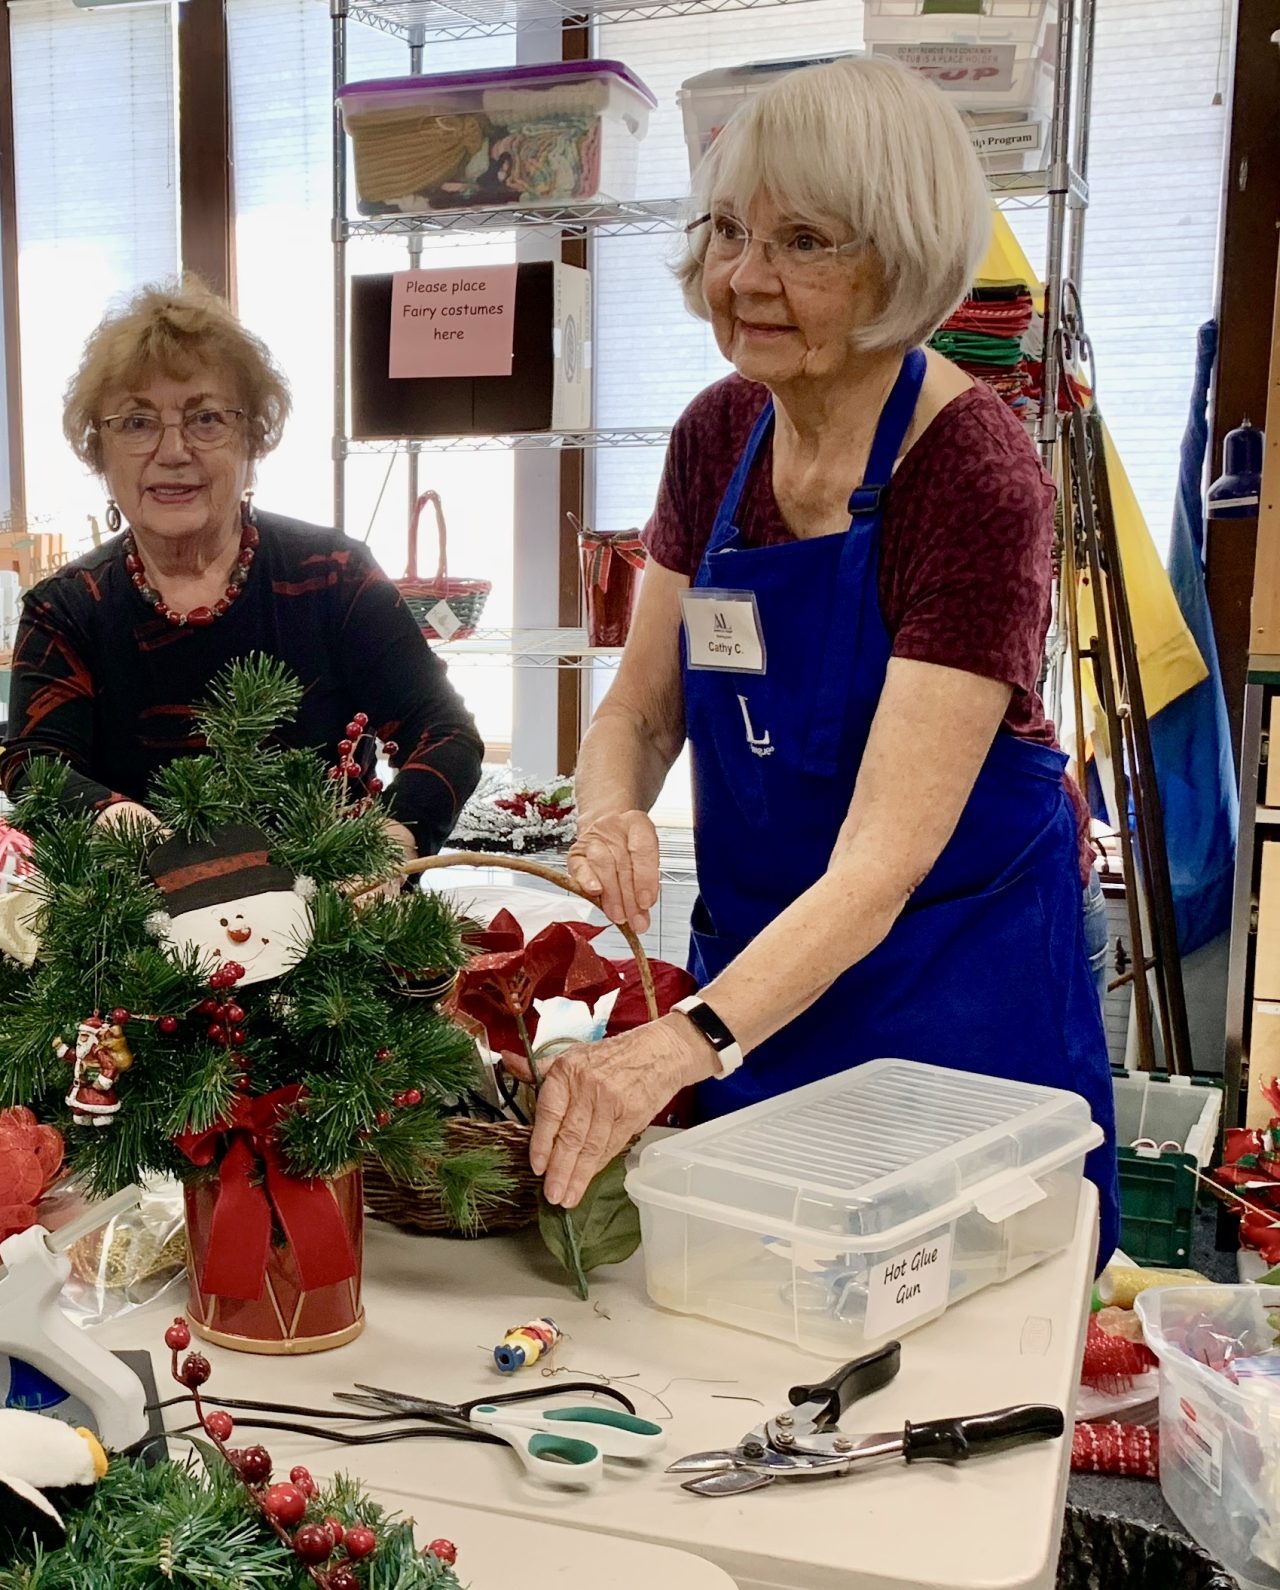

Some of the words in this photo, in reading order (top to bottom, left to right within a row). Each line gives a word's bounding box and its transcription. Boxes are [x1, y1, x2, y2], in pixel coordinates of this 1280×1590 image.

[987, 133, 1032, 147] Program
[406, 280, 448, 293] Please
[451, 279, 487, 295] place
[403, 304, 437, 320] Fairy
[441, 304, 504, 316] costumes
[434, 327, 465, 340] here
[708, 641, 733, 656] Cathy
[734, 643, 744, 655] C.
[883, 1259, 908, 1285] Hot
[911, 1248, 938, 1271] Glue
[896, 1284, 921, 1304] Gun
